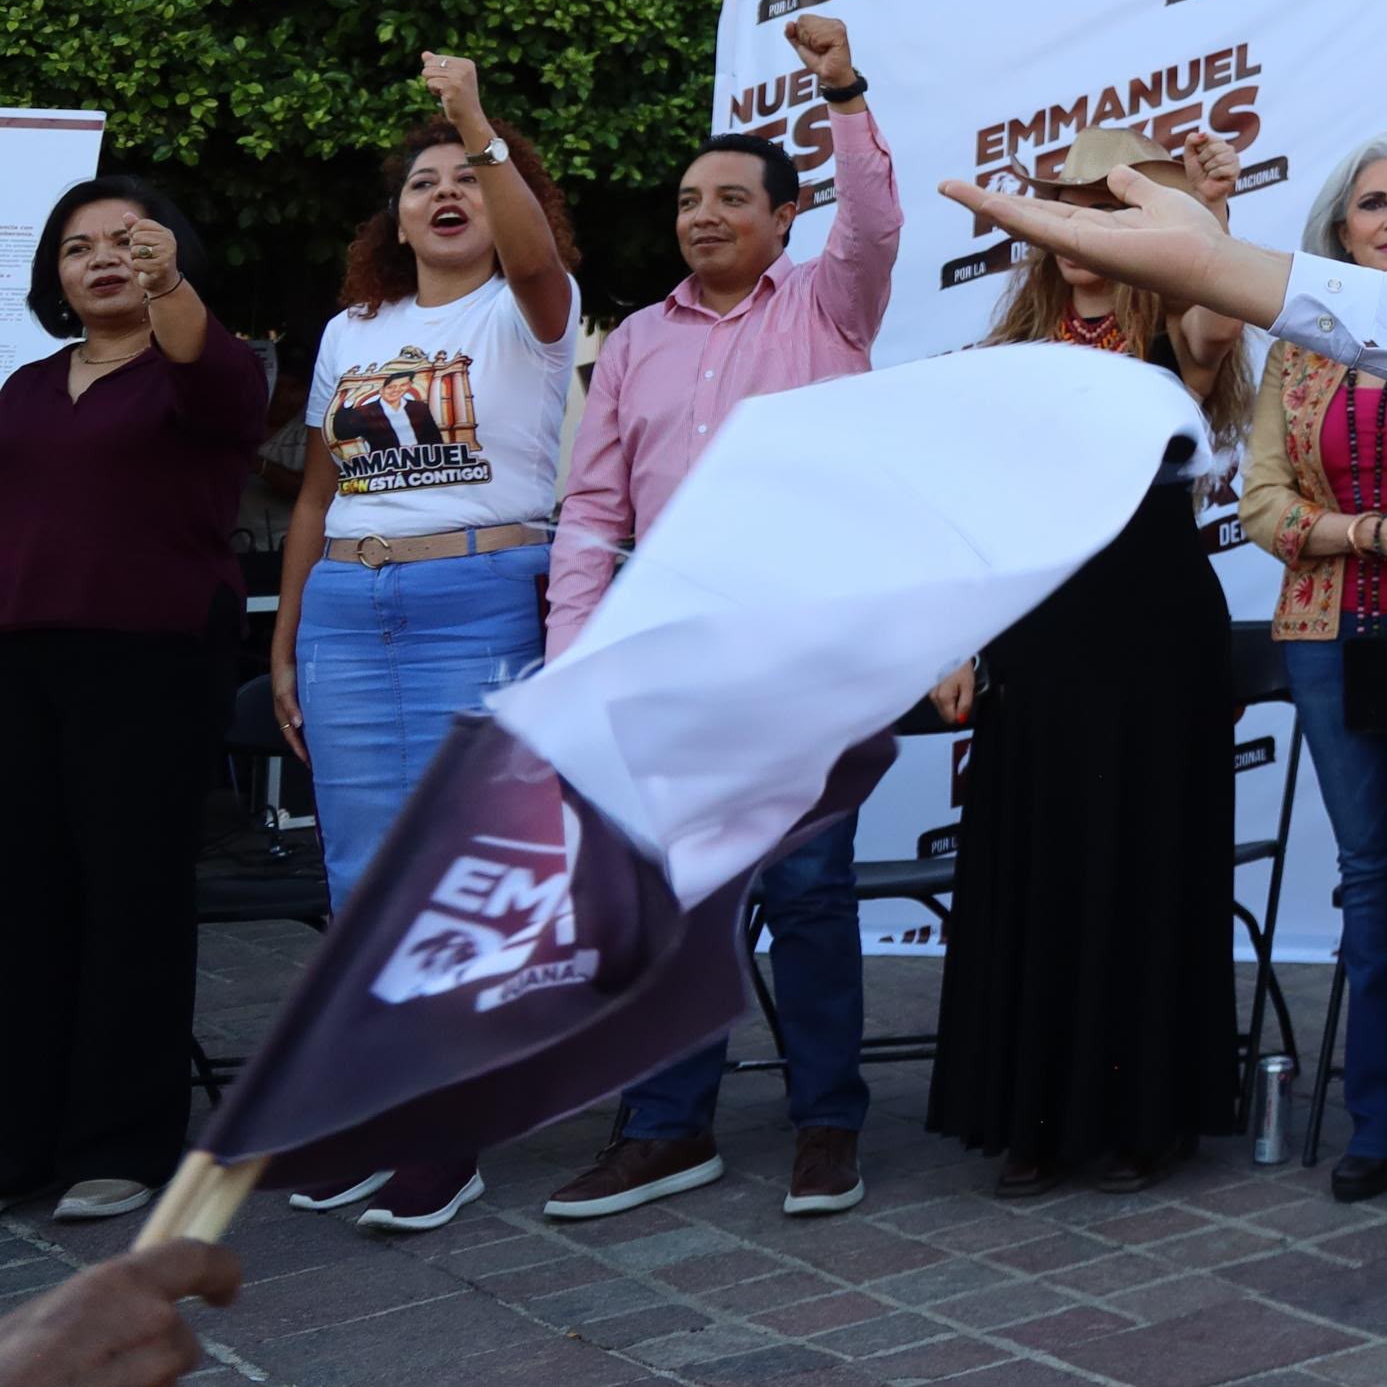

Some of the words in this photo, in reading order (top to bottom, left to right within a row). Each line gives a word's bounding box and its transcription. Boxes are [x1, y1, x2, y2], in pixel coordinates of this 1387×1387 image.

[768, 0, 786, 16] POR
[976, 42, 1261, 166] EMMANUEL
[1235, 166, 1281, 192] NACIONAL
[954, 267, 971, 283] POR
[973, 262, 986, 275] LA
[369, 472, 407, 491] ESTÁ
[408, 466, 488, 487] CONTIGO!
[931, 837, 948, 854] POR
